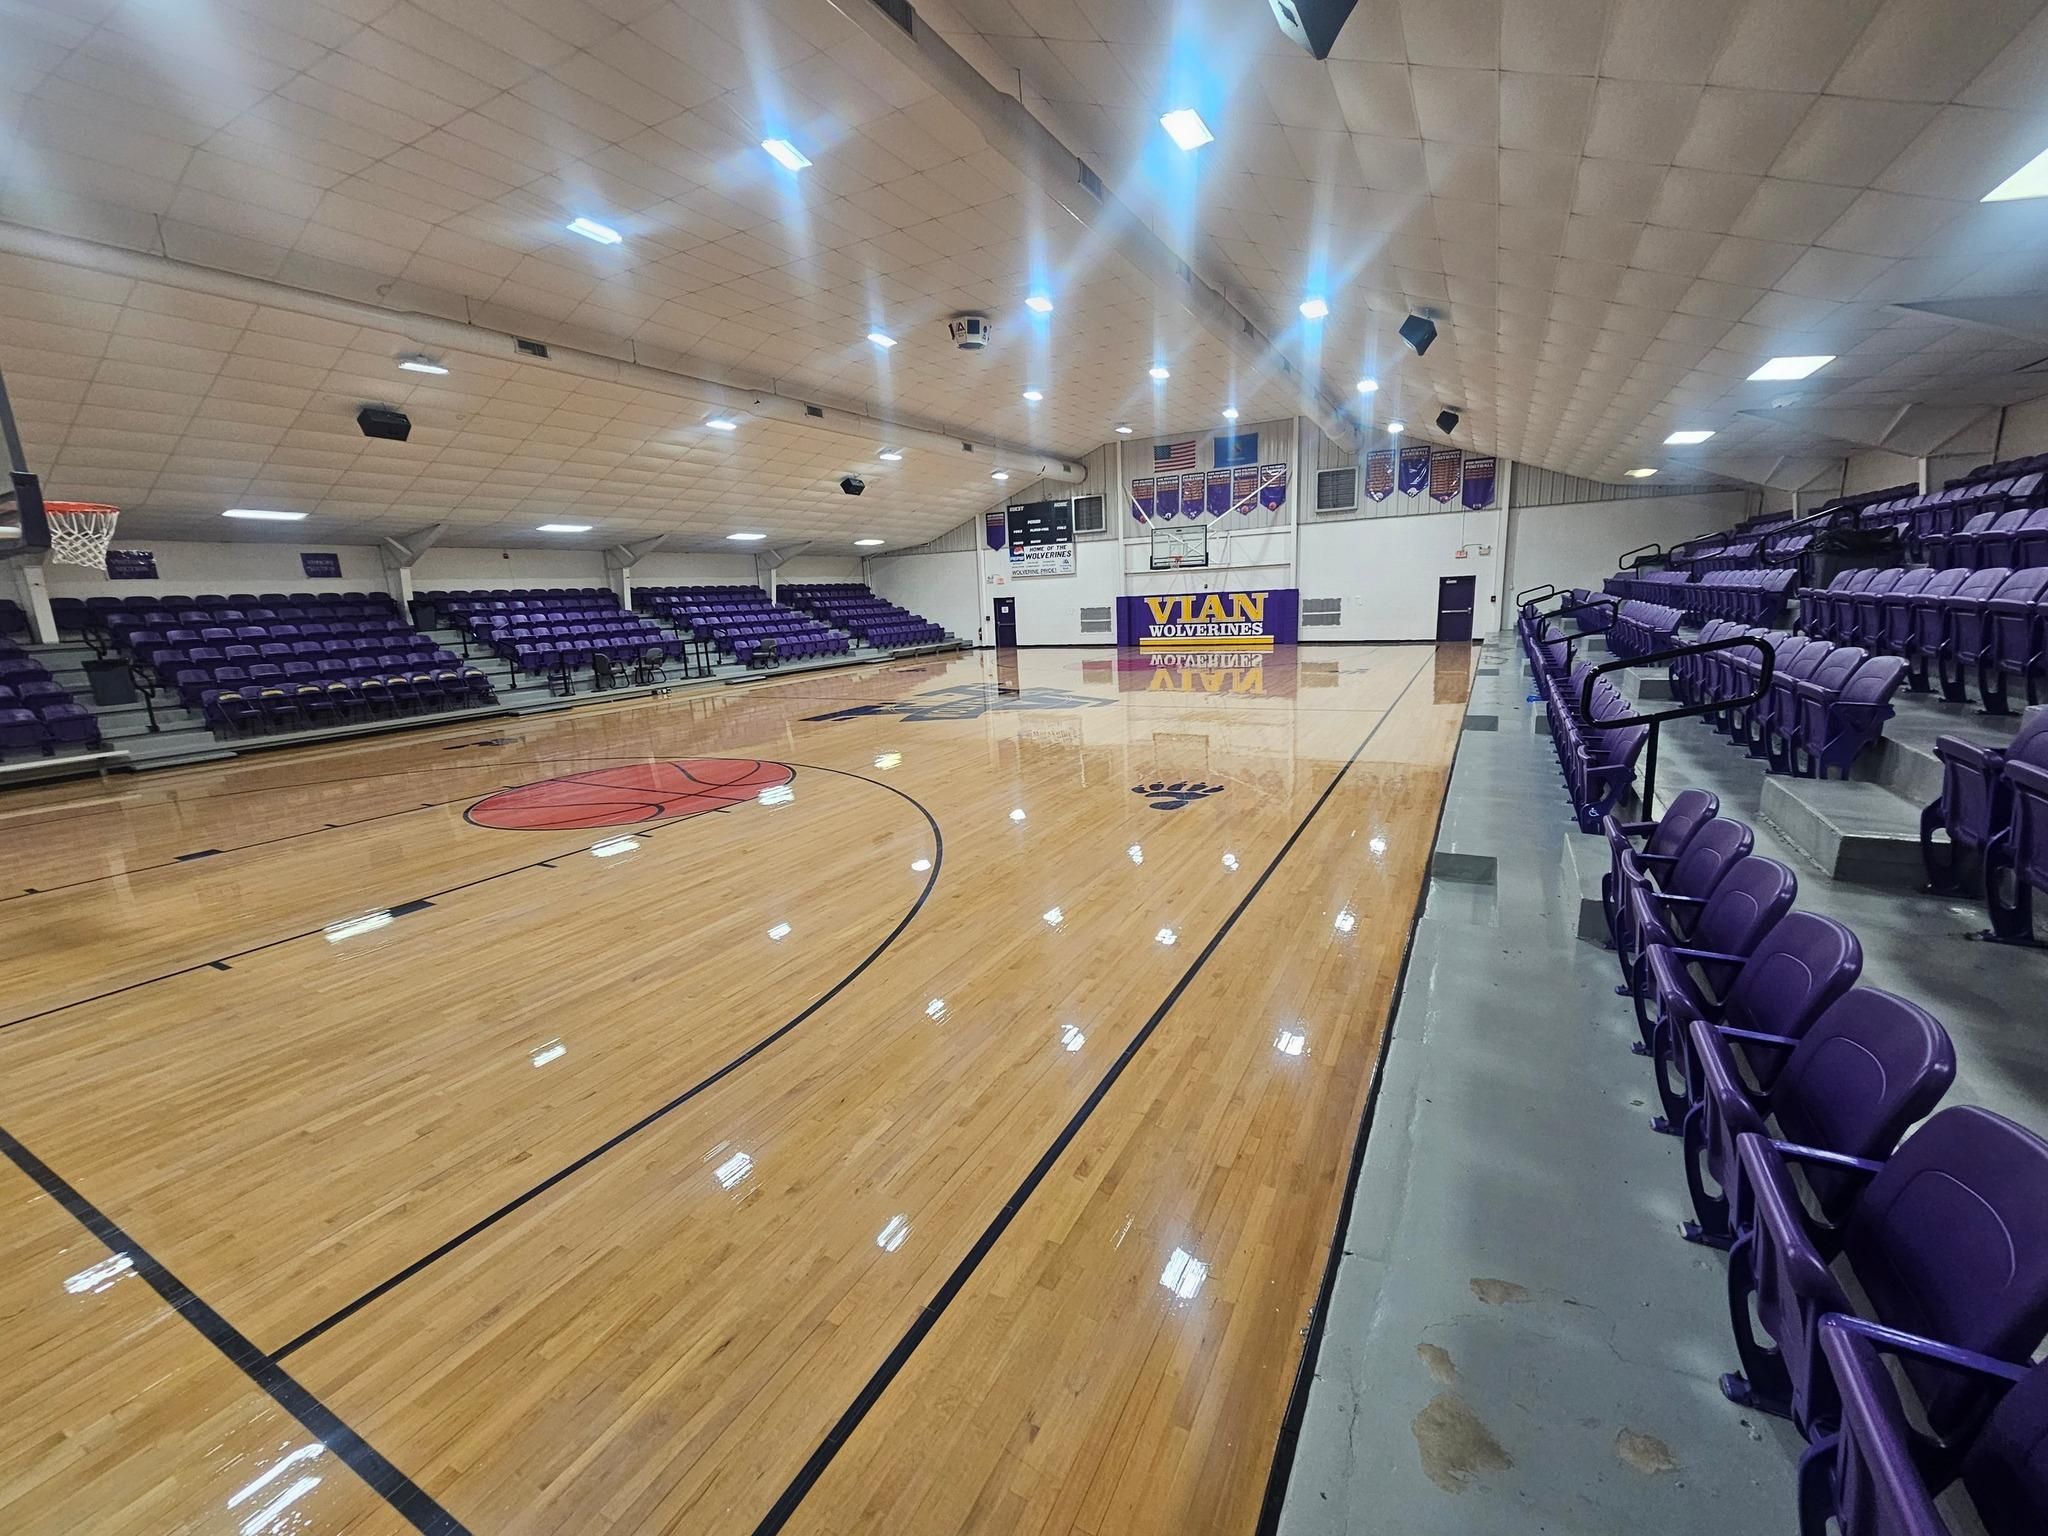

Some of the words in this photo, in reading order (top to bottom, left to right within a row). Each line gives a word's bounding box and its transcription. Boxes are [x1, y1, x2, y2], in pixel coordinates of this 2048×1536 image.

[1025, 550, 1072, 560] WOLVERINES
[1144, 592, 1269, 624] VIAN
[1149, 622, 1263, 637] WOLVERINES
